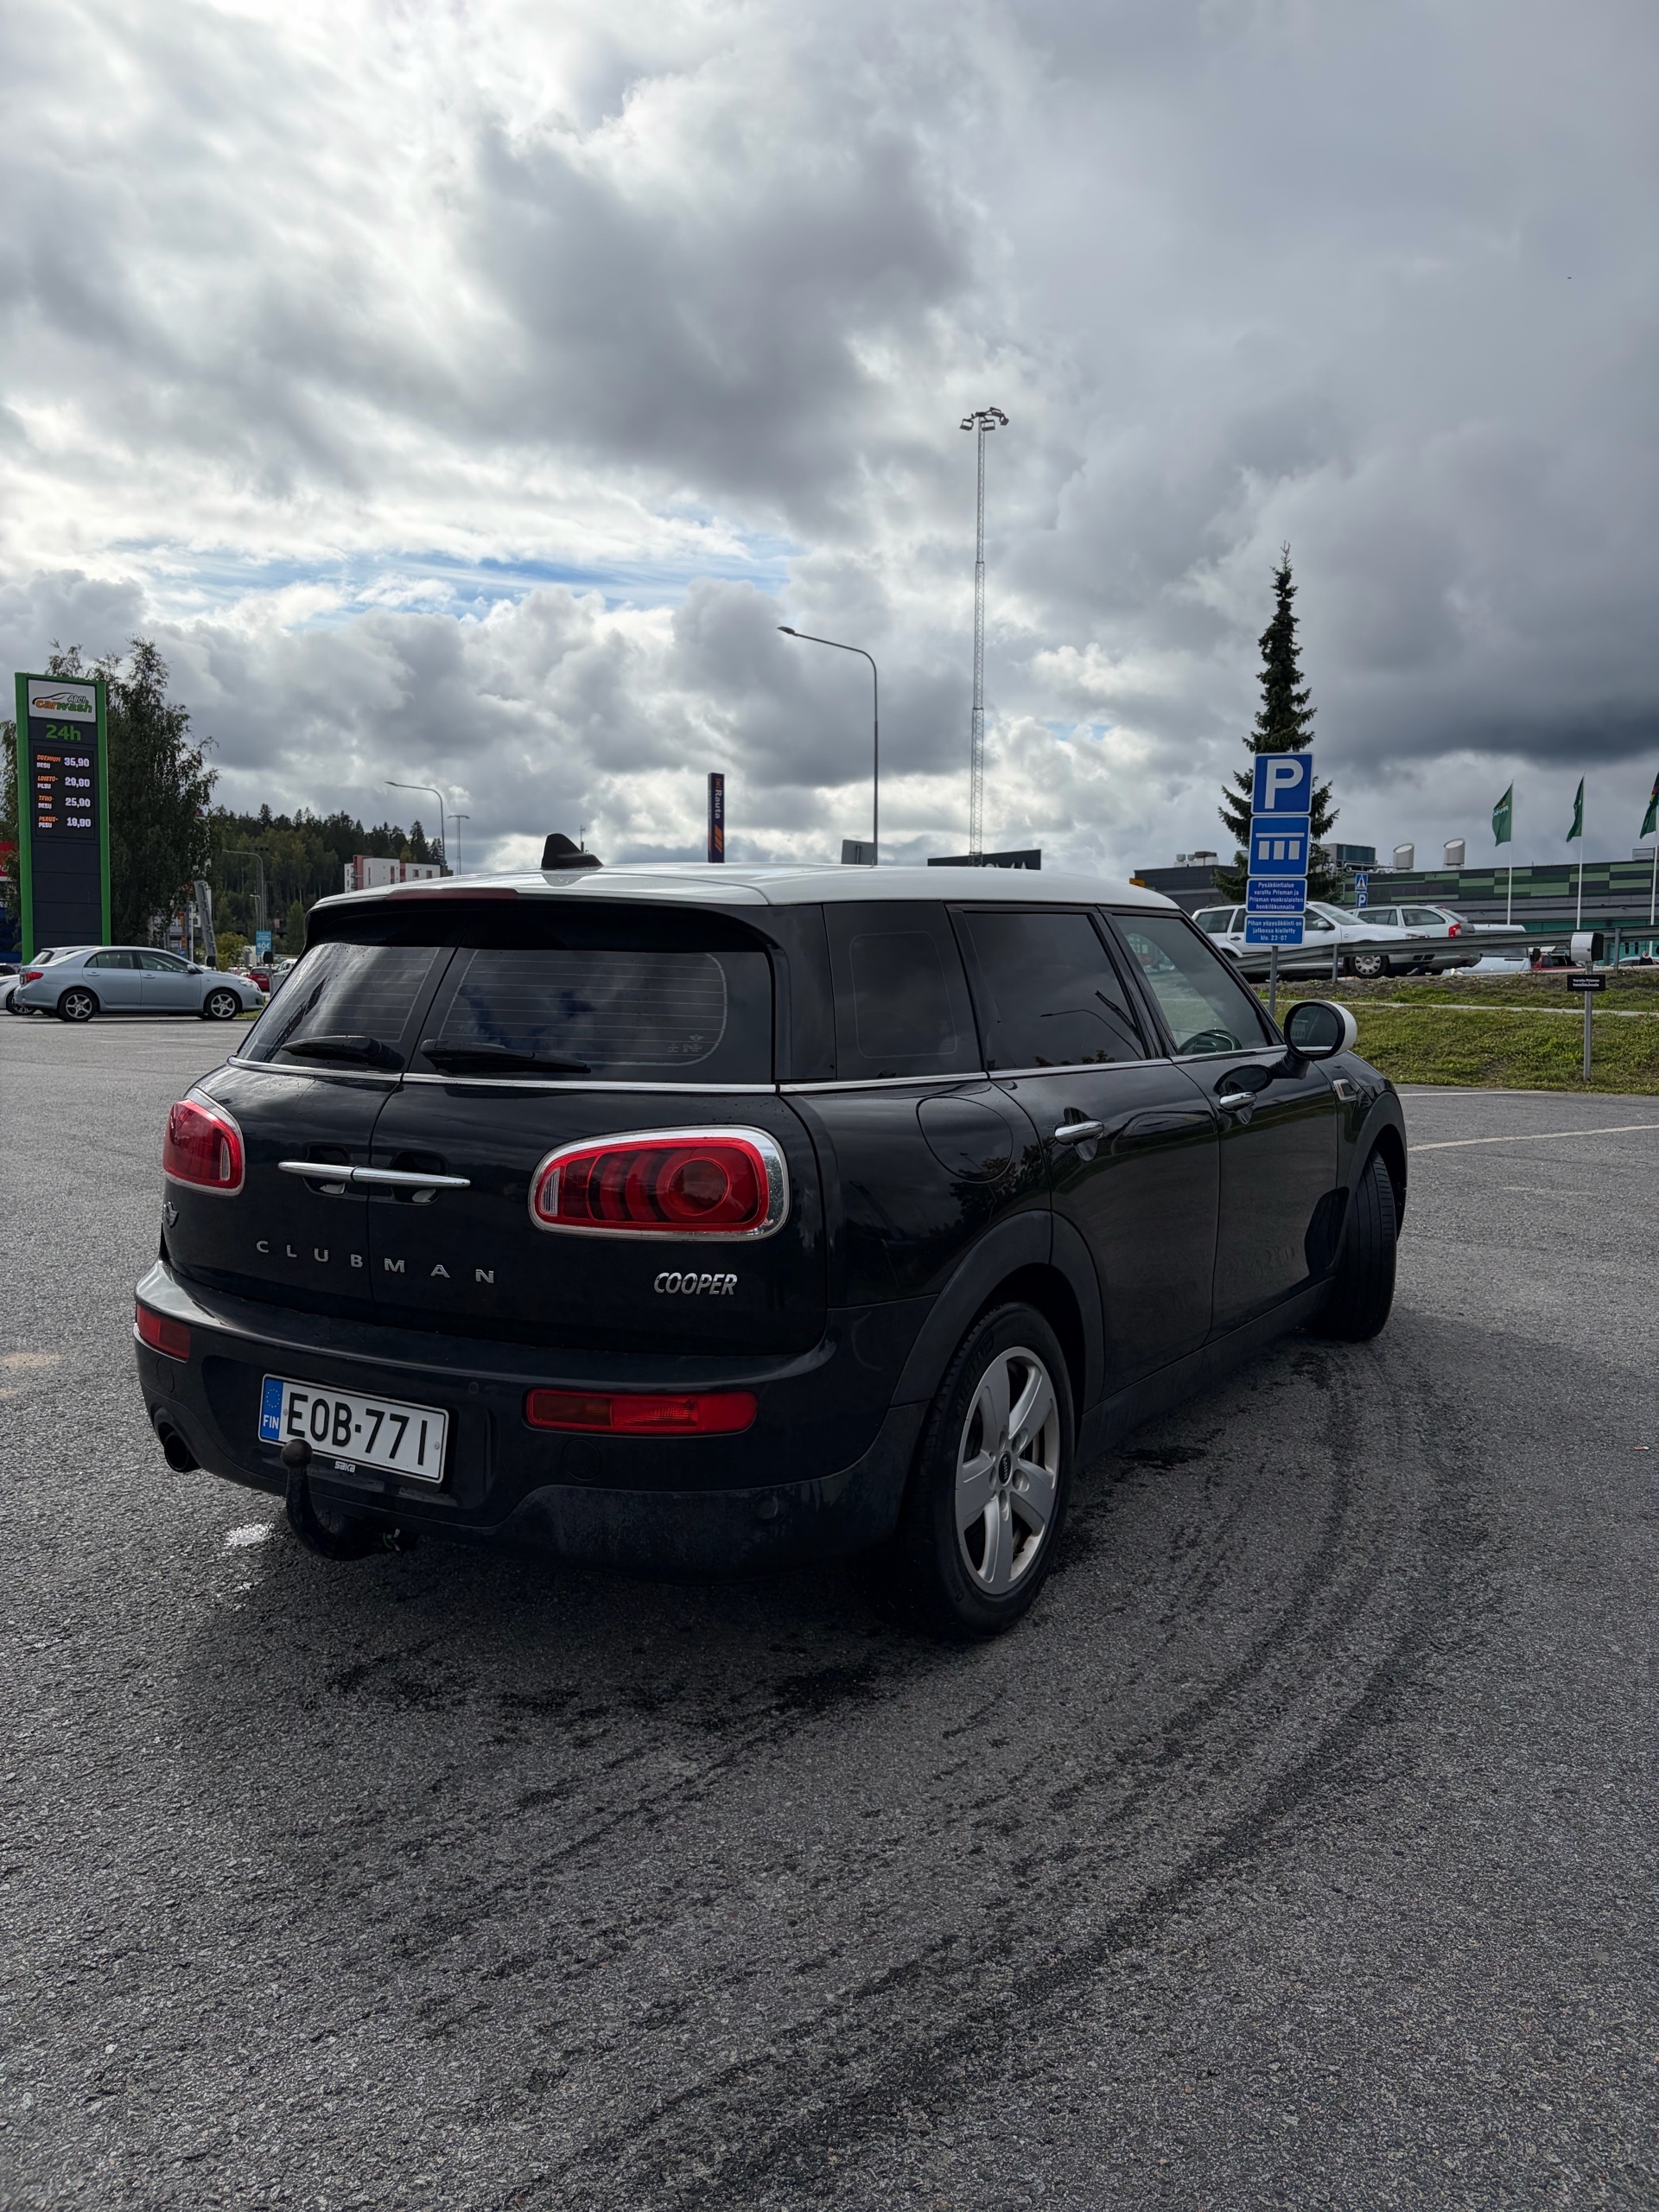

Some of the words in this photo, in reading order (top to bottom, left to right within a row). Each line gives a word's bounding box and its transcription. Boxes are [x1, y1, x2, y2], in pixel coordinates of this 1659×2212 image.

[67, 695, 86, 704] ABC!
[35, 700, 92, 713] carwash
[45, 724, 81, 741] 24h
[64, 757, 90, 767] 35,90
[65, 777, 91, 788] 29,90
[1264, 759, 1304, 809] P
[65, 798, 91, 808] 25,90
[67, 817, 92, 829] 19,90
[1358, 894, 1366, 906] P
[256, 1240, 495, 1284] CLUBMAN
[653, 1272, 738, 1295] COOPER
[263, 1414, 280, 1430] FIN
[287, 1392, 428, 1465] EOB-771
